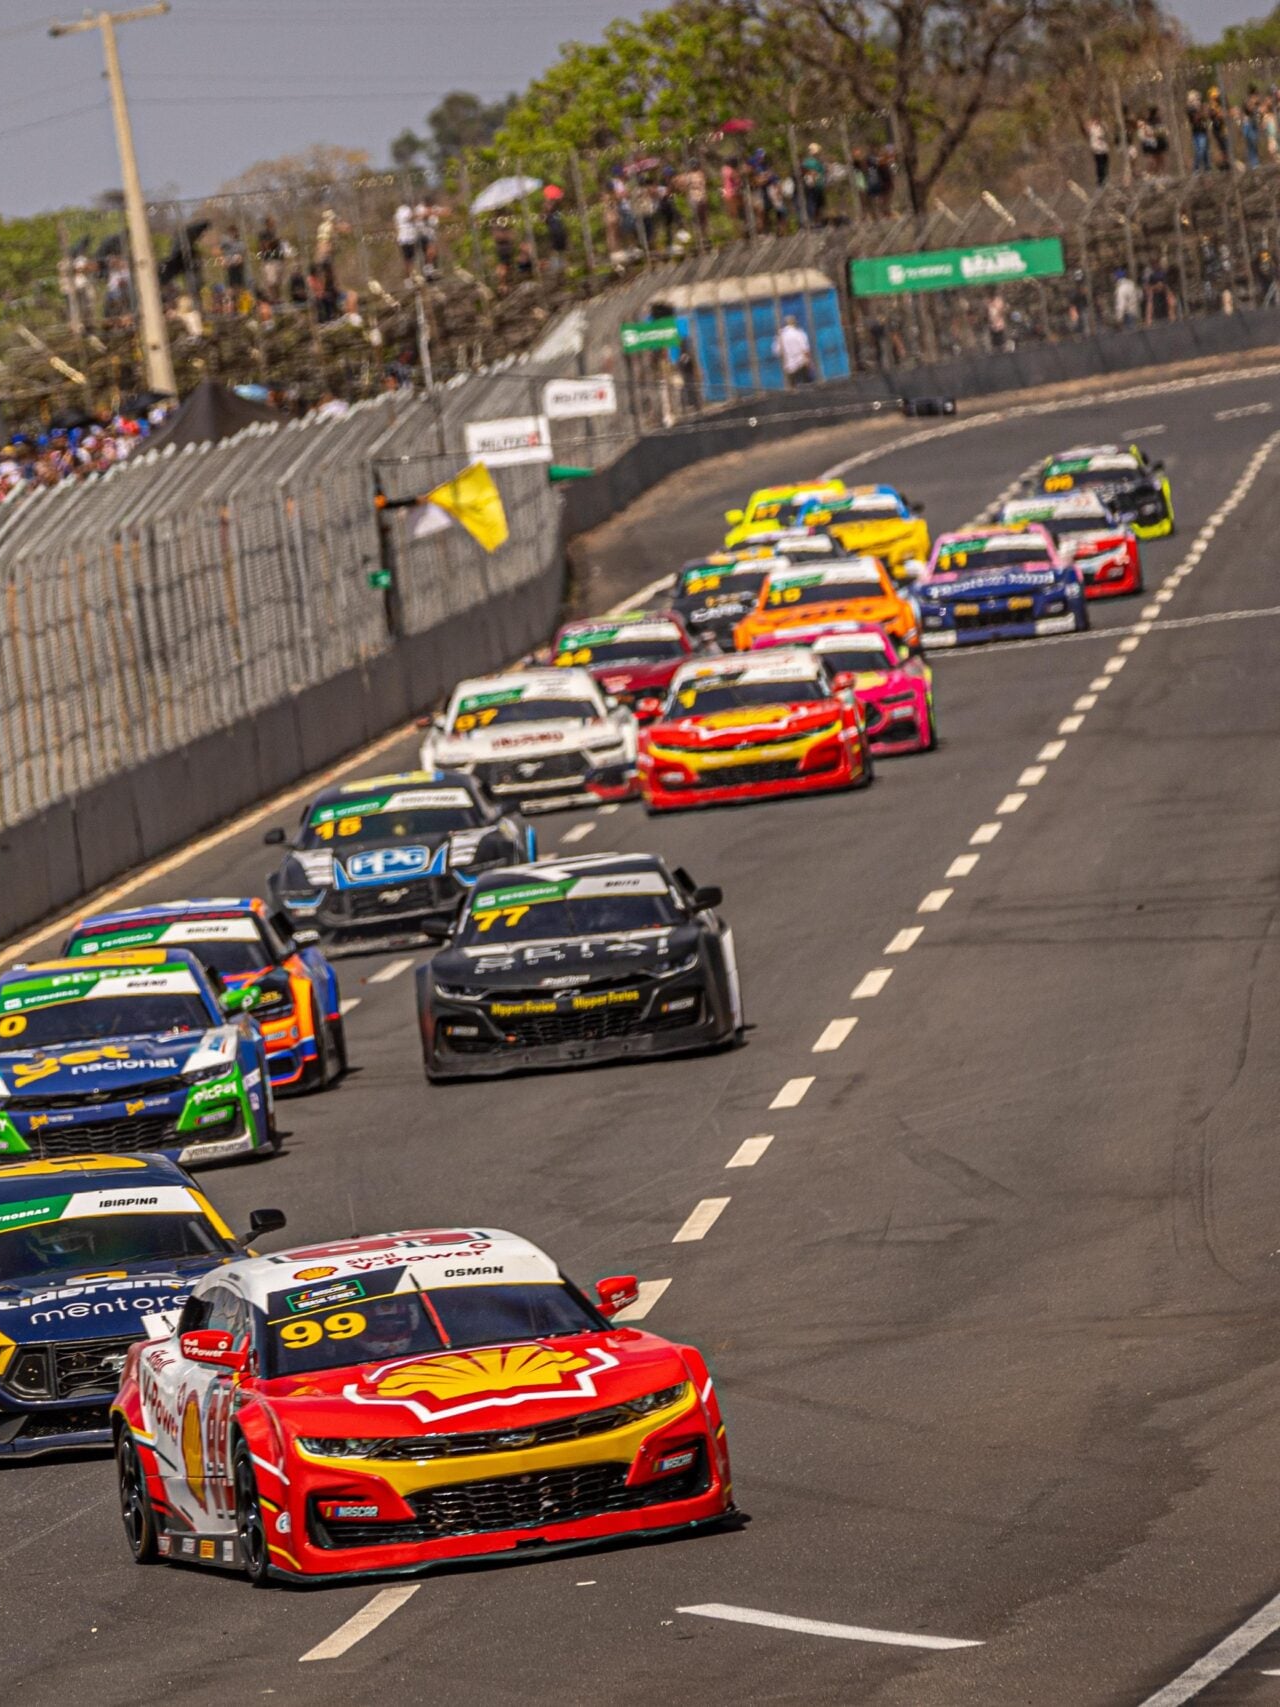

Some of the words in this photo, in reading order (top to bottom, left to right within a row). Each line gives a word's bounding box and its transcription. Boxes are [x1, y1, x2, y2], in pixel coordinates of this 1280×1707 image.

[473, 905, 530, 932] 77
[71, 1057, 179, 1076] nacional
[99, 1197, 158, 1208] IBIAPINA
[346, 1253, 396, 1265] Shell
[351, 1250, 485, 1270] V-Power
[444, 1266, 504, 1278] OSMAN
[280, 1312, 367, 1349] 99
[184, 1346, 223, 1357] V-Power
[662, 1453, 693, 1471] NASCAR
[337, 1505, 378, 1517] NASCAR
